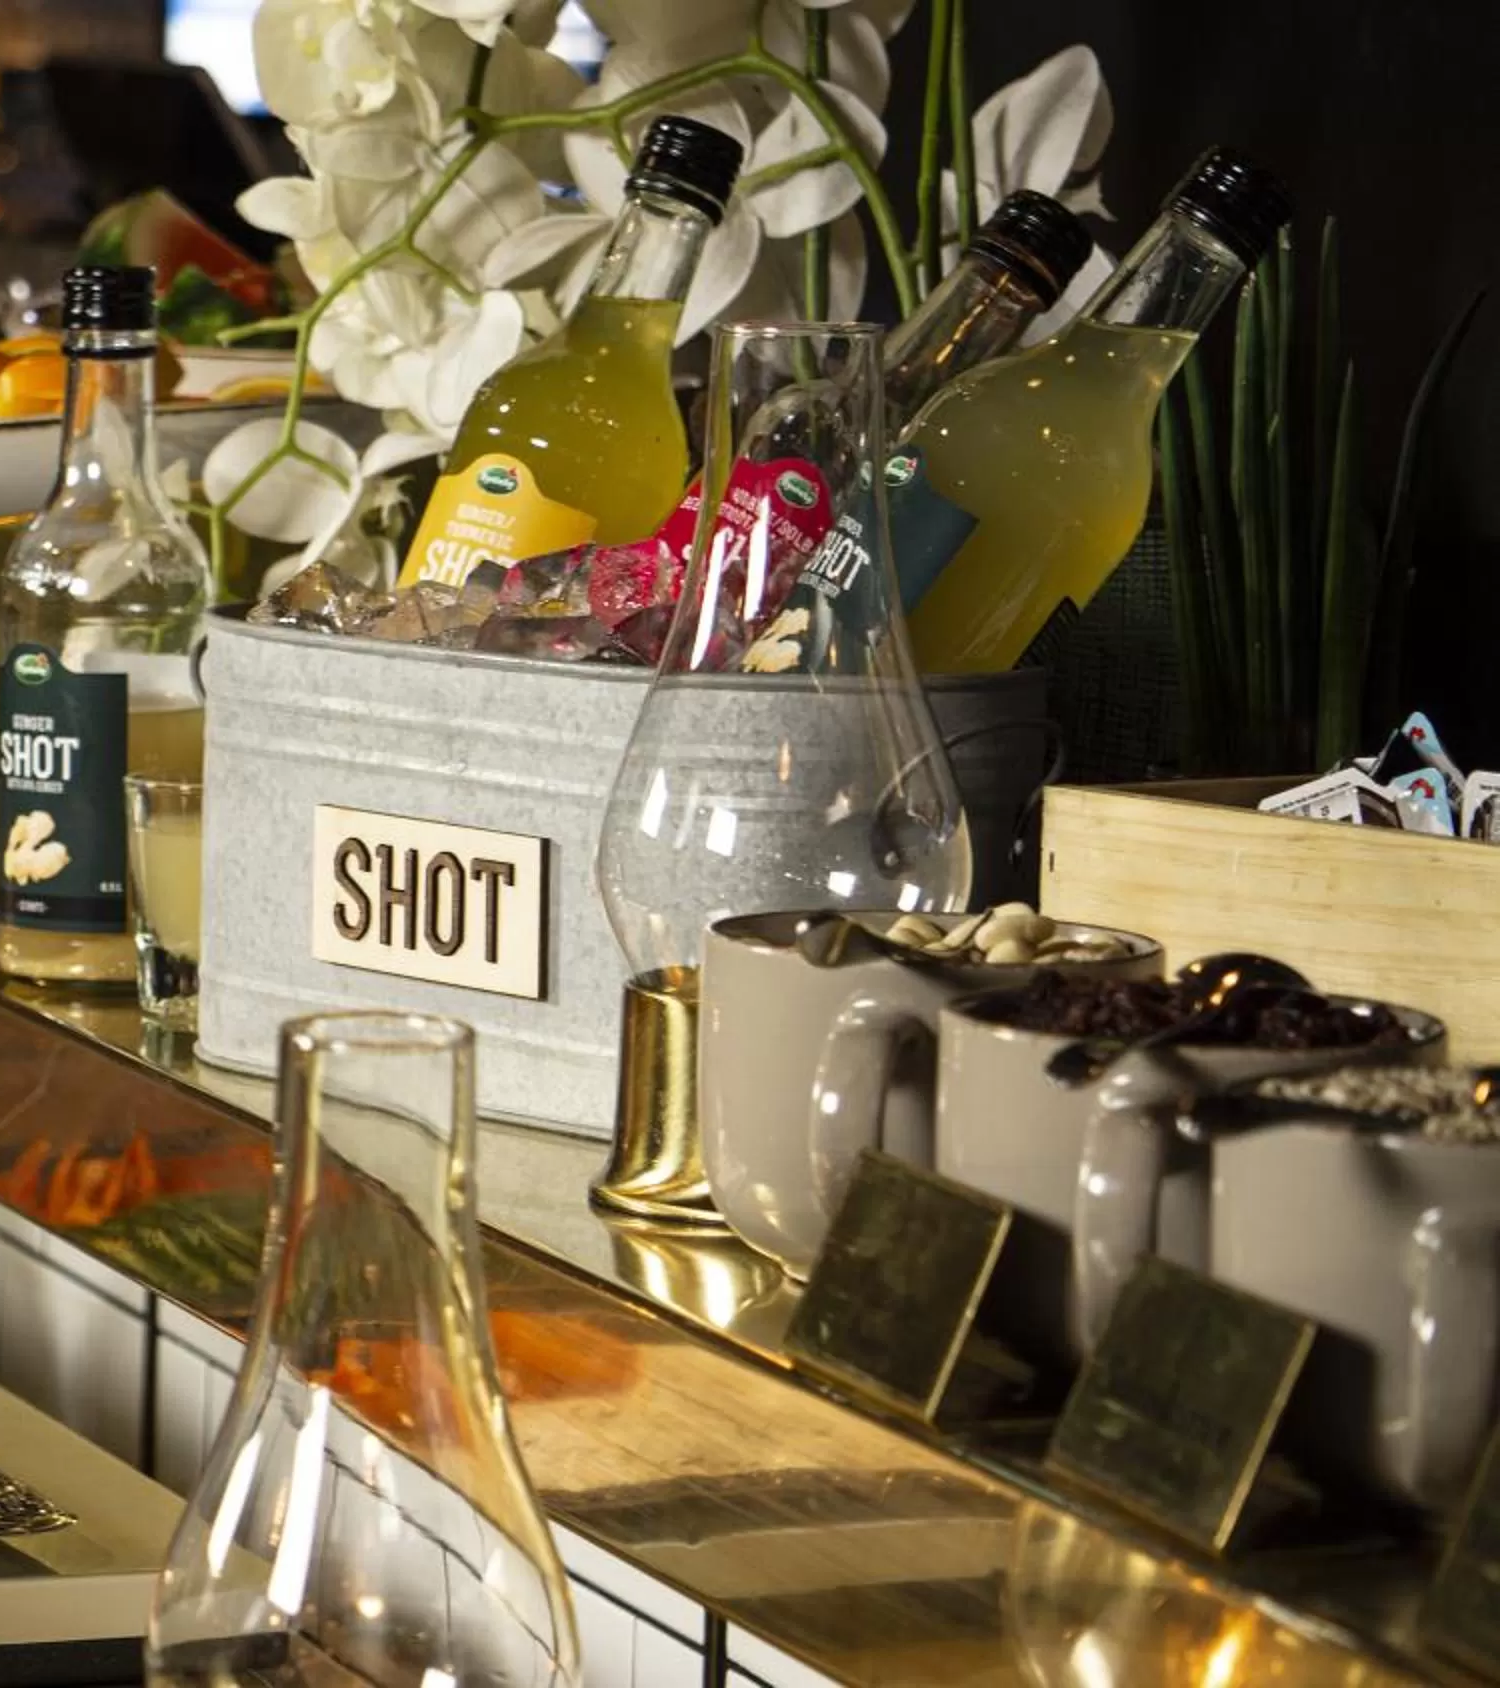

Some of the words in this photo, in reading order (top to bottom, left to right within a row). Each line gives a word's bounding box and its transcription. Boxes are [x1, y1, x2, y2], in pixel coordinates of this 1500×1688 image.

[418, 538, 520, 587] SHO
[0, 731, 80, 780] SHOT
[334, 837, 515, 964] SHOT
